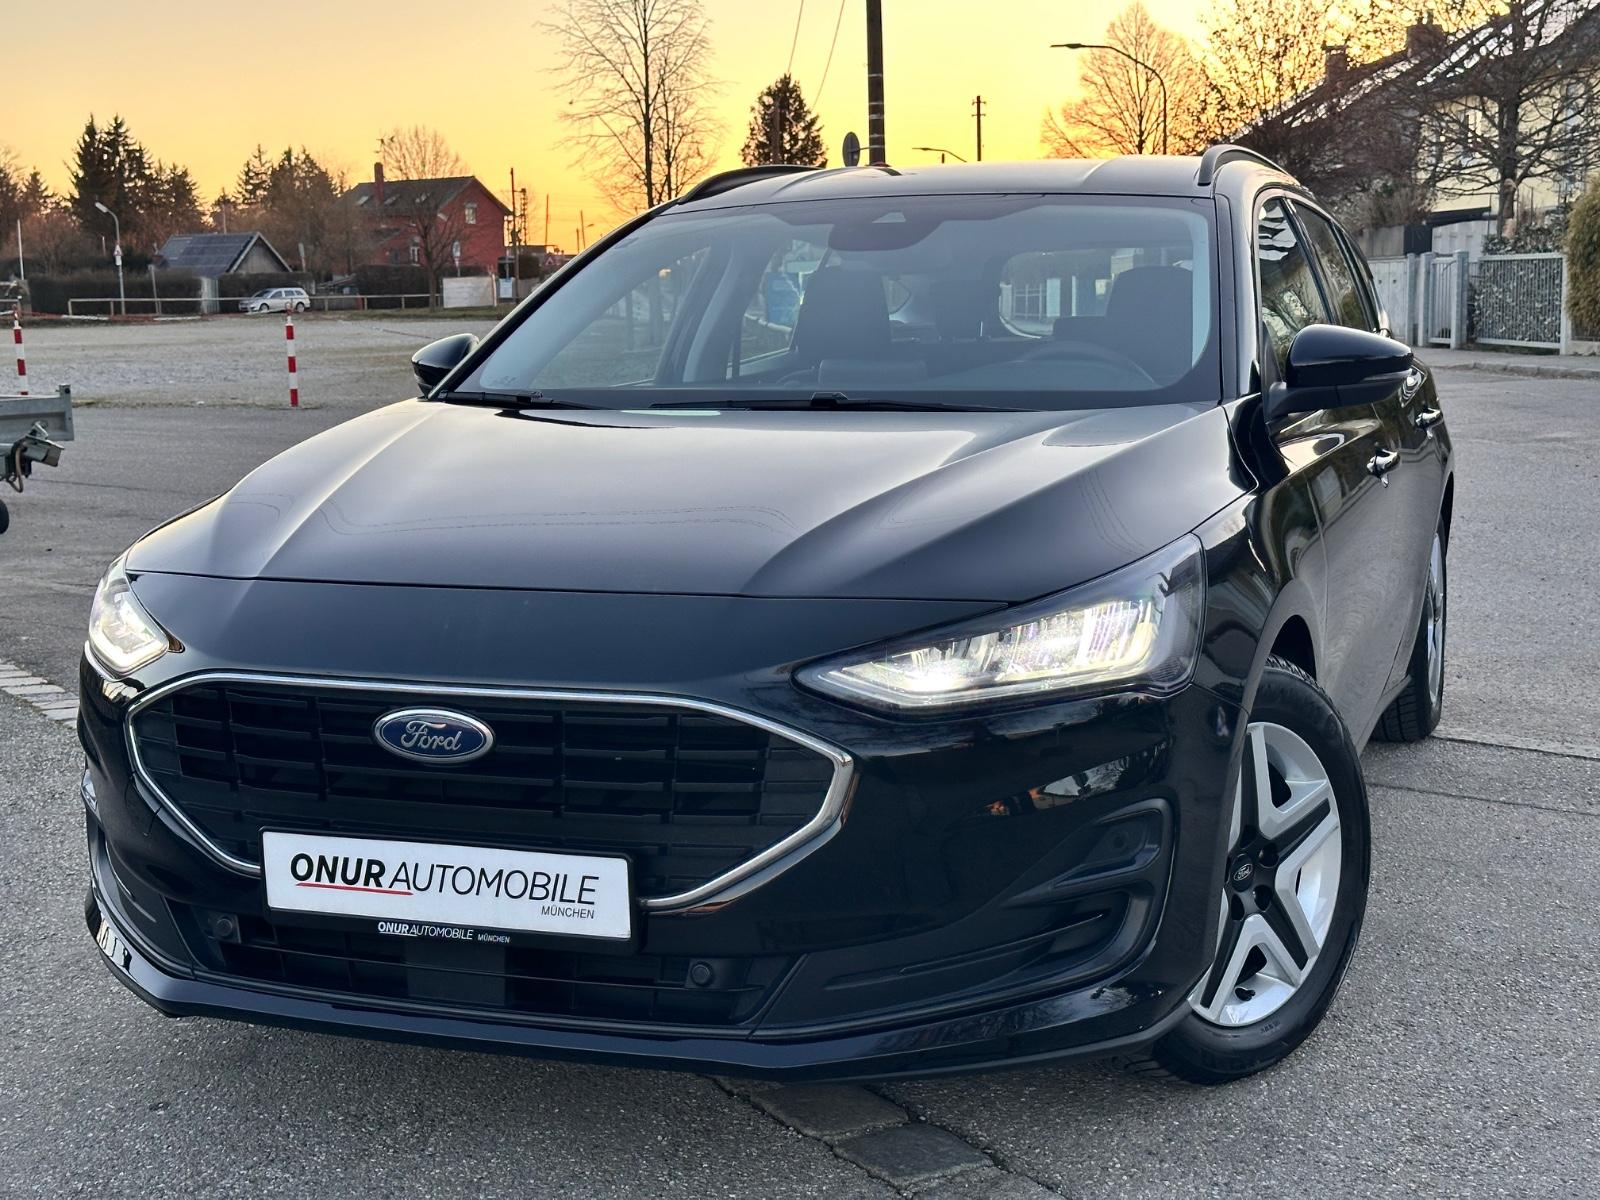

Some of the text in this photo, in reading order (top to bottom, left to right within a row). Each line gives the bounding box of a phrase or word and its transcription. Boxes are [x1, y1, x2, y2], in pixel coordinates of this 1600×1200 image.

[400, 720, 462, 751] Ford
[541, 905, 596, 919] MÜNCHEN
[477, 932, 510, 944] MÜNCHEN
